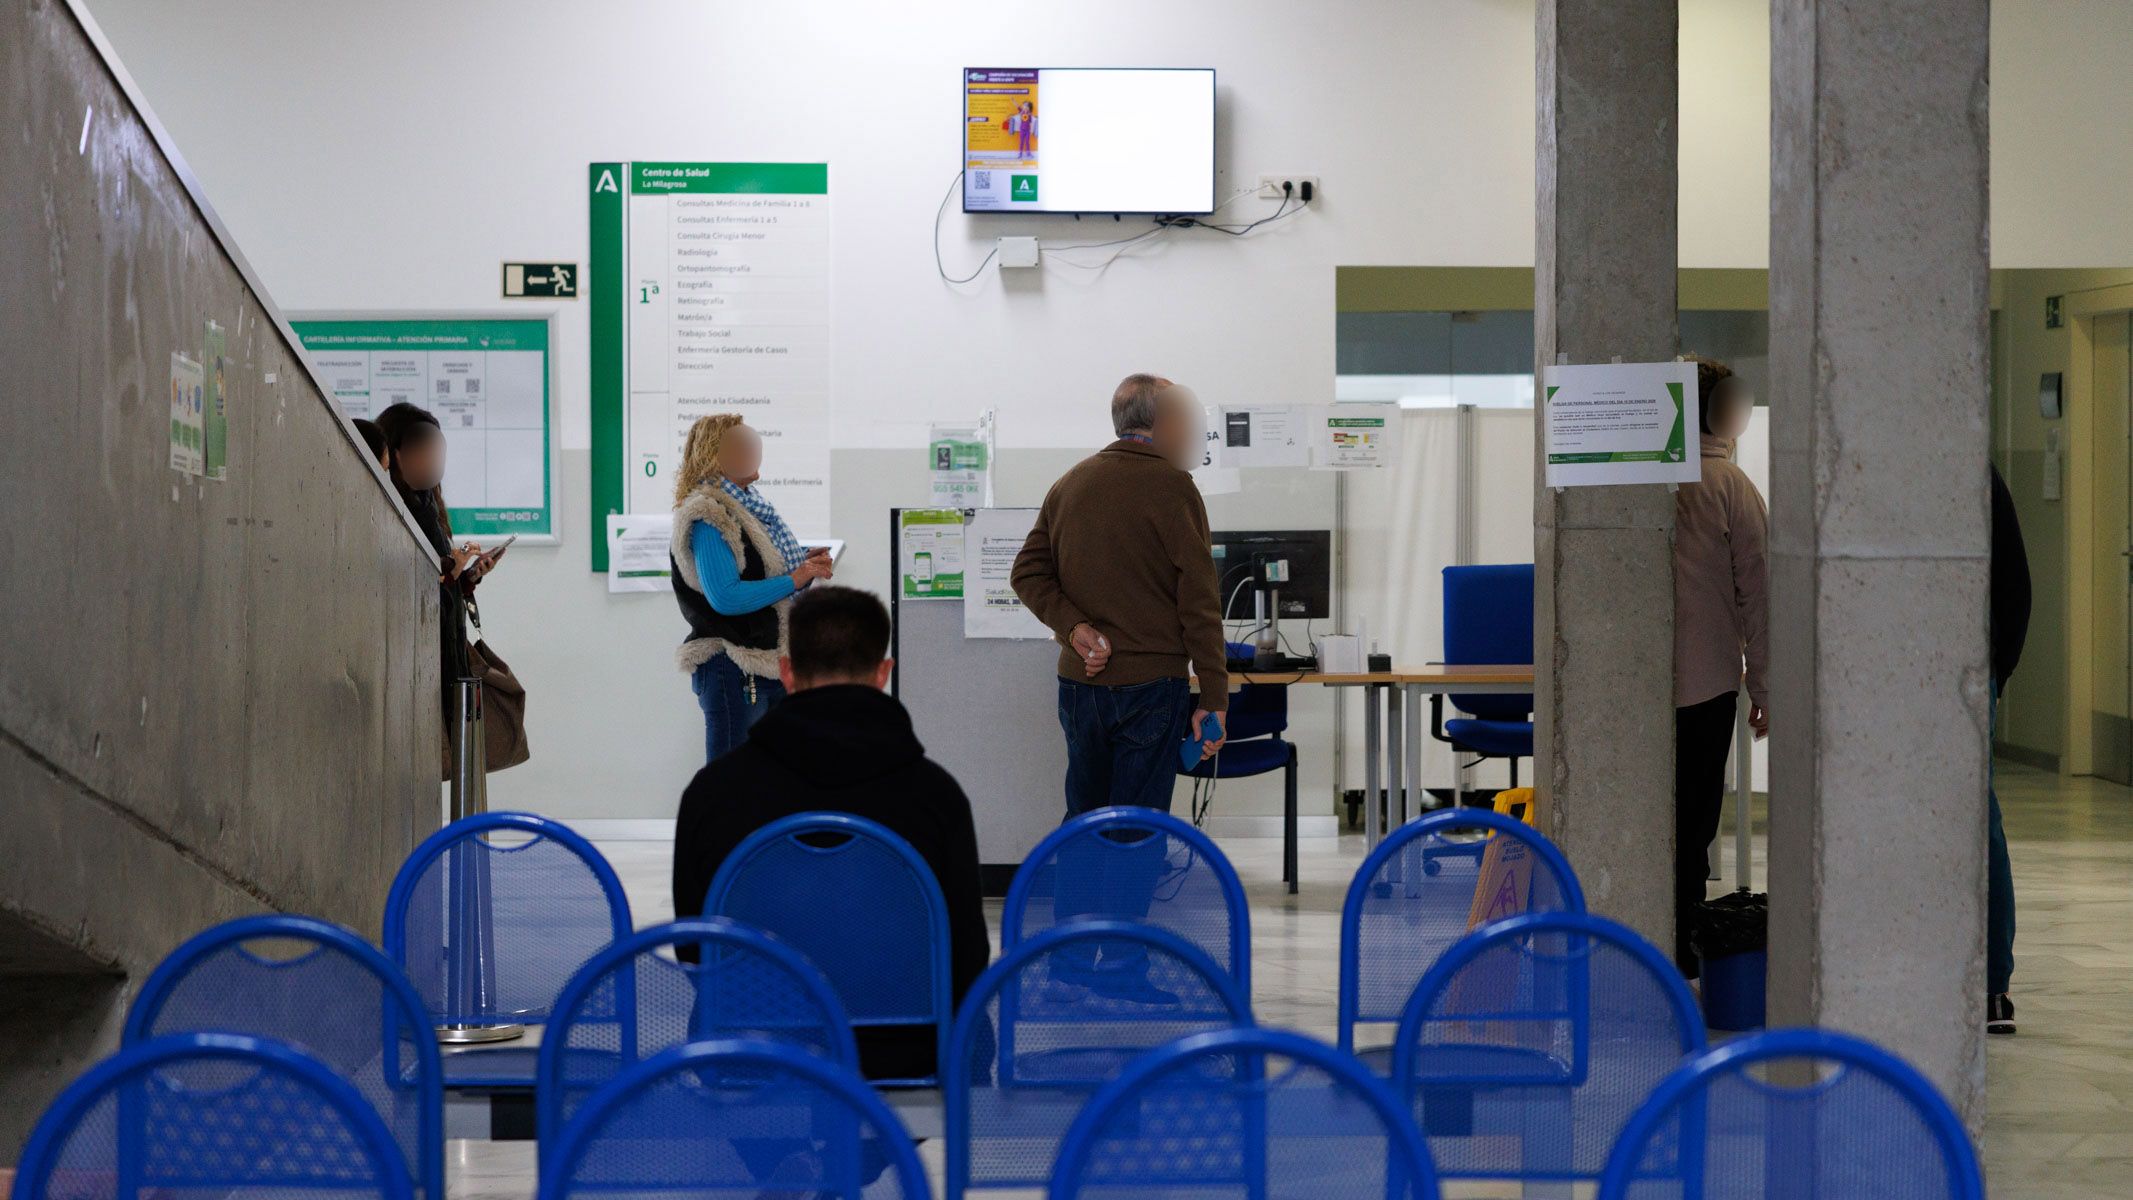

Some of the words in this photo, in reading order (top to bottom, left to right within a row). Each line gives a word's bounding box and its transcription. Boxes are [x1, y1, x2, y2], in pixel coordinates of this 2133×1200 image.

[642, 168, 671, 177] Centro
[673, 168, 684, 177] de
[685, 168, 710, 177] Salud
[652, 180, 687, 189] Milagrosa
[678, 314, 712, 322] Matrón/a
[678, 330, 706, 338] Trabajo
[397, 335, 432, 344] ATENCIÓN
[645, 460, 657, 478] 0
